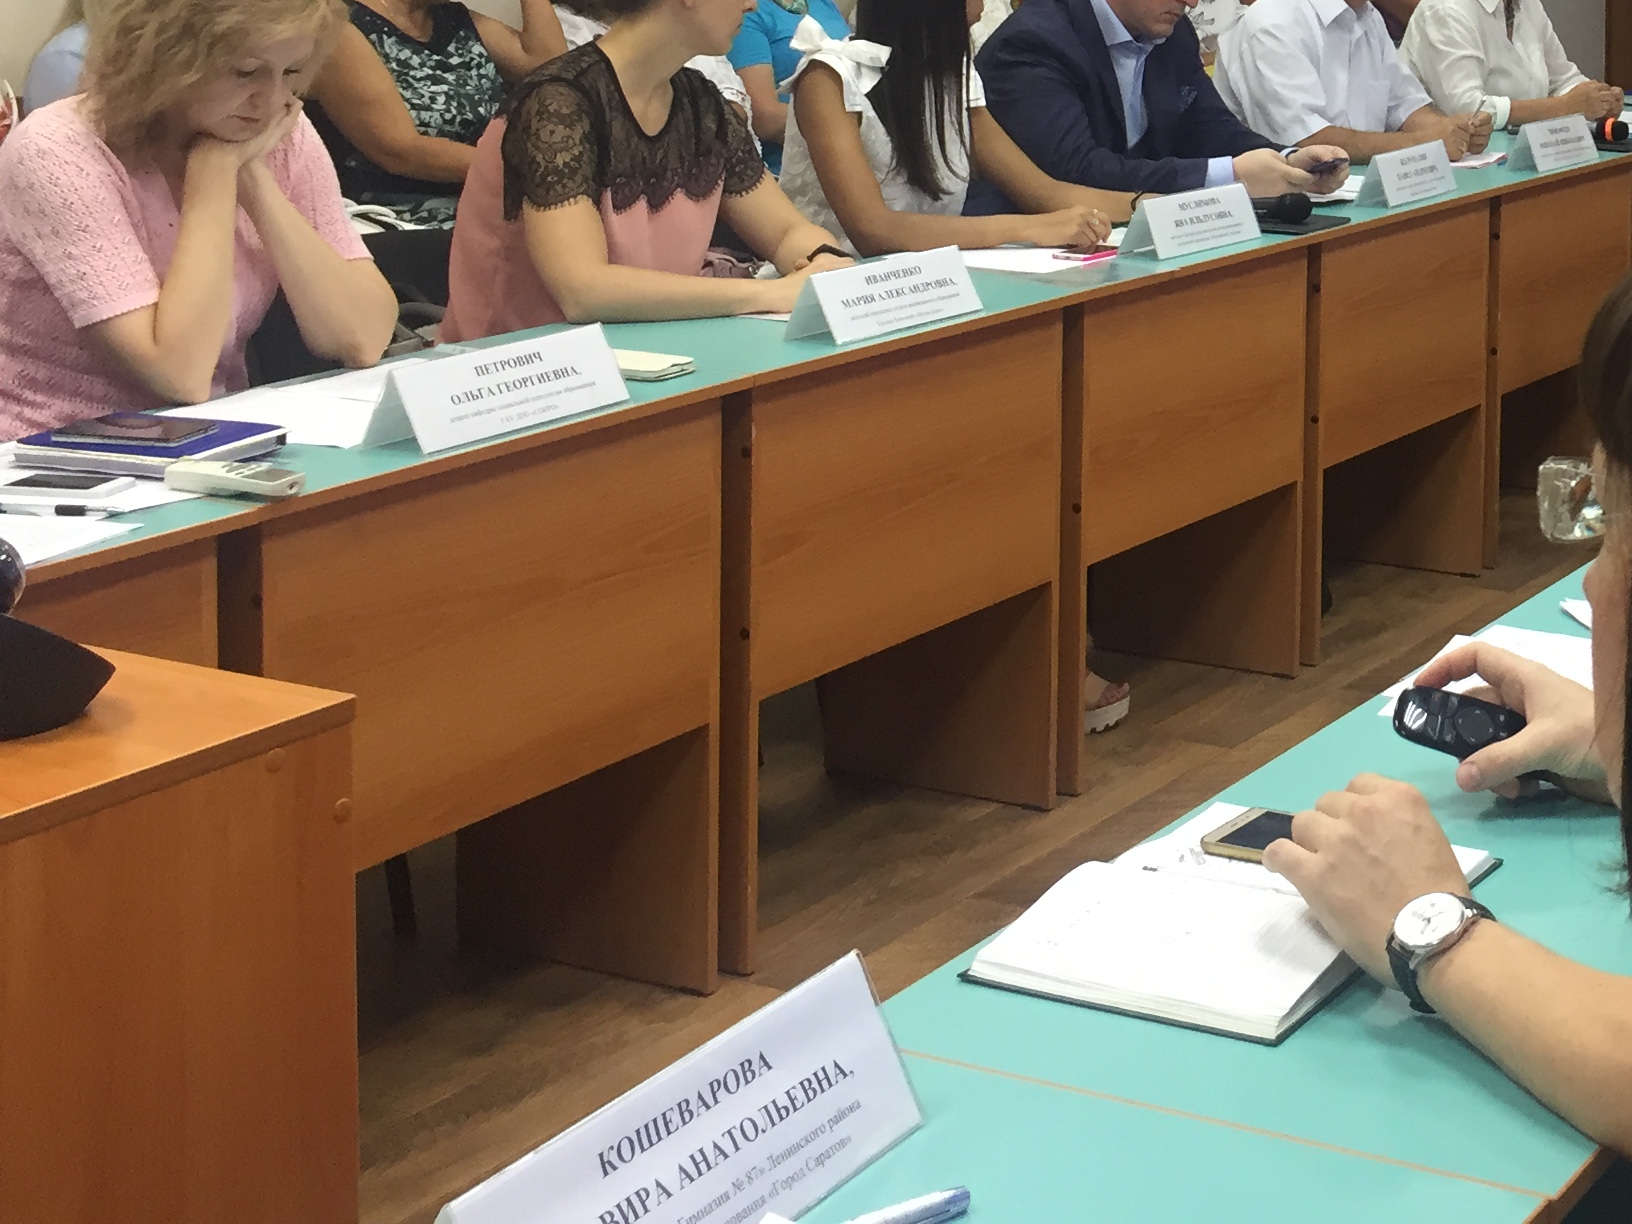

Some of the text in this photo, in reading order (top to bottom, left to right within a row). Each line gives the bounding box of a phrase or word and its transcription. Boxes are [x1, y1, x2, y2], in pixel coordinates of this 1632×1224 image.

[841, 293, 876, 309] МАРИЯ
[864, 266, 922, 285] ИВАНЧЕНКО
[450, 366, 582, 405] ОЛЬГА ГЕОРГИЕВНА,
[474, 352, 544, 376] ПЕТРОВИЧ
[597, 1051, 774, 1179] КОШЕВАРОВА
[597, 1059, 855, 1224] ВИРА АНАТОЛЬЕВНА,
[731, 1180, 746, 1197] №
[747, 1166, 765, 1185] 87»
[766, 1124, 827, 1171] Ленинского
[828, 1096, 863, 1133] района
[768, 1168, 806, 1199] «Город
[805, 1135, 852, 1173] Саратов»
